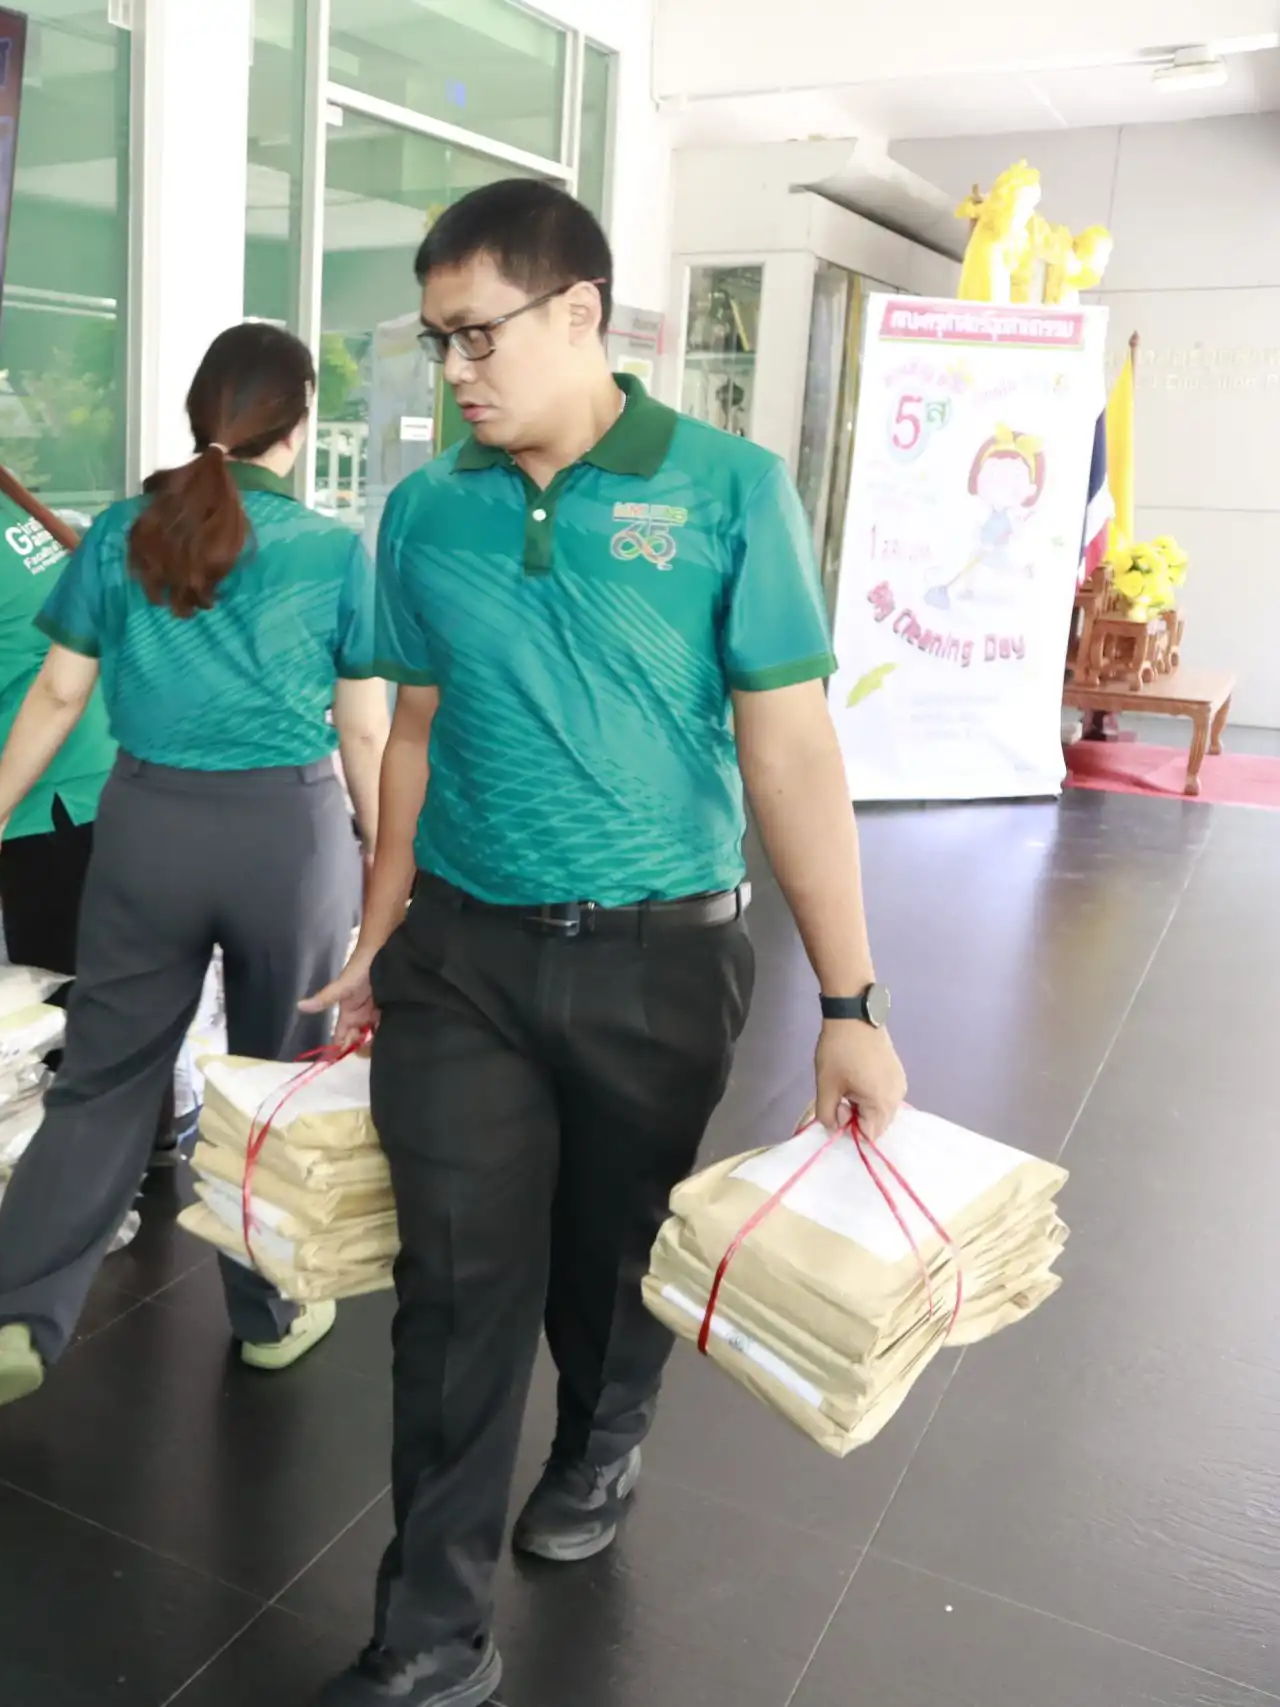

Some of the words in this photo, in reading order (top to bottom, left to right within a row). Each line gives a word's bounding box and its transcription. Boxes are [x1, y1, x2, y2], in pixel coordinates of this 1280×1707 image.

[890, 393, 951, 451] 5ส
[892, 608, 976, 668] Cleaning
[983, 633, 1026, 662] Day
